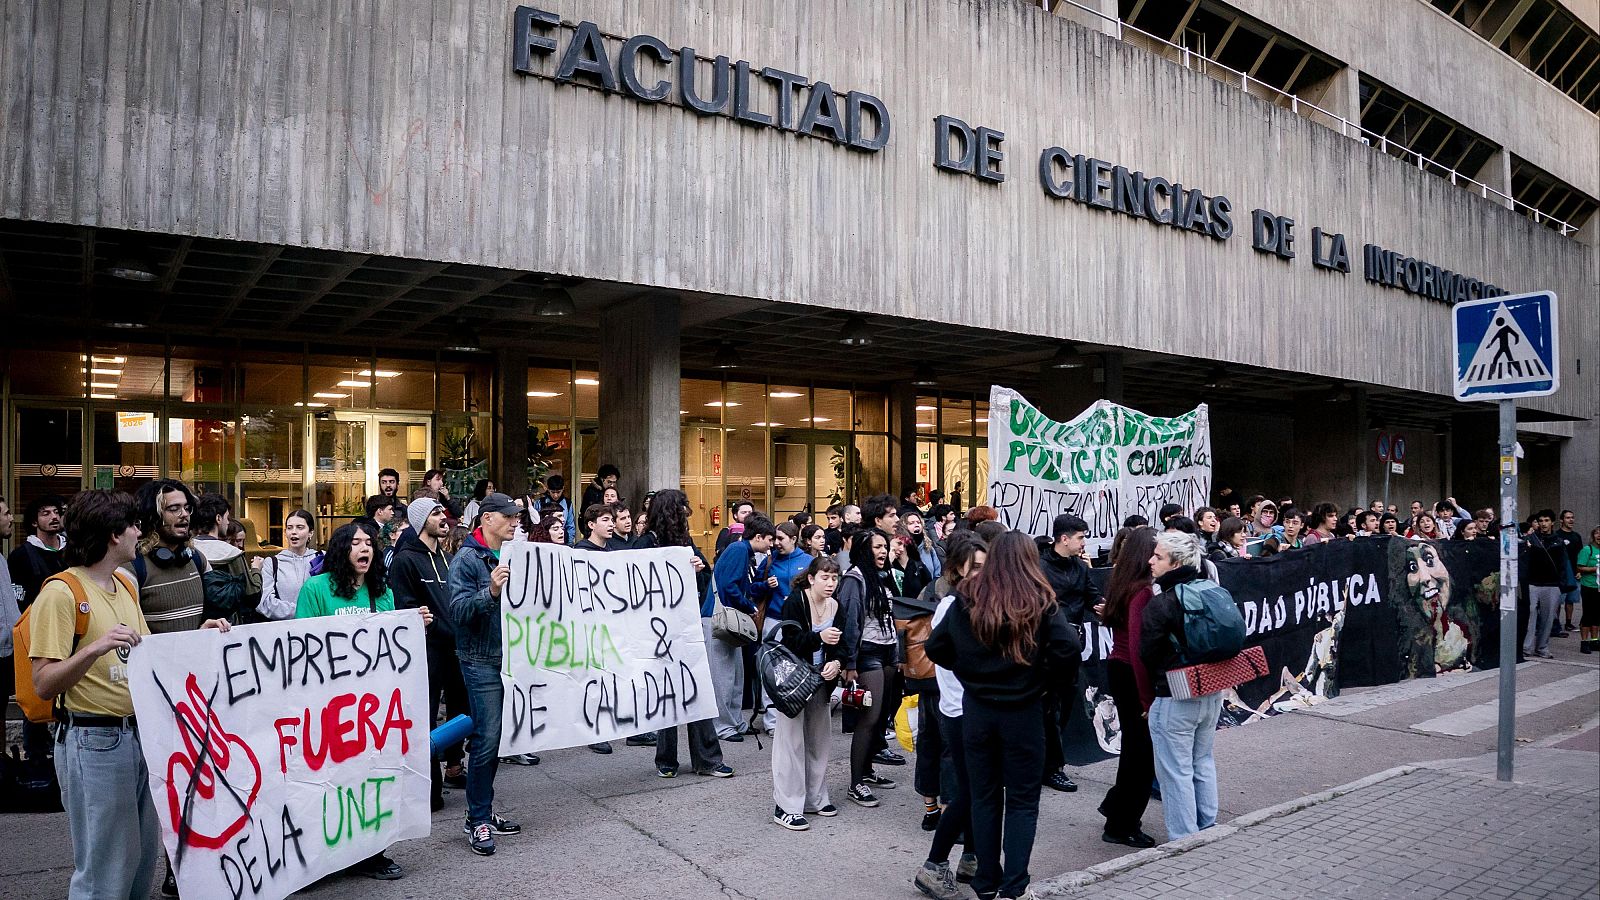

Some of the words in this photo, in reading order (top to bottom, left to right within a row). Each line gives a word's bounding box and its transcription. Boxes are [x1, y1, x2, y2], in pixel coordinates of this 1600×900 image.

[514, 5, 890, 152] FACULTAD
[934, 115, 1004, 183] DE
[1040, 146, 1233, 241] CIENCIAS
[1252, 208, 1295, 259] DE
[1312, 226, 1350, 273] LA
[1364, 244, 1510, 305] INFORMACI
[506, 546, 684, 621] UNIVERSIDAD
[223, 625, 412, 705] EMPRESAS
[505, 612, 624, 677] PÚBLICA
[650, 617, 673, 662] &
[274, 688, 412, 773] FUERA
[511, 683, 547, 743] DE
[583, 660, 697, 735] CALIDAD
[322, 776, 395, 847] UNI
